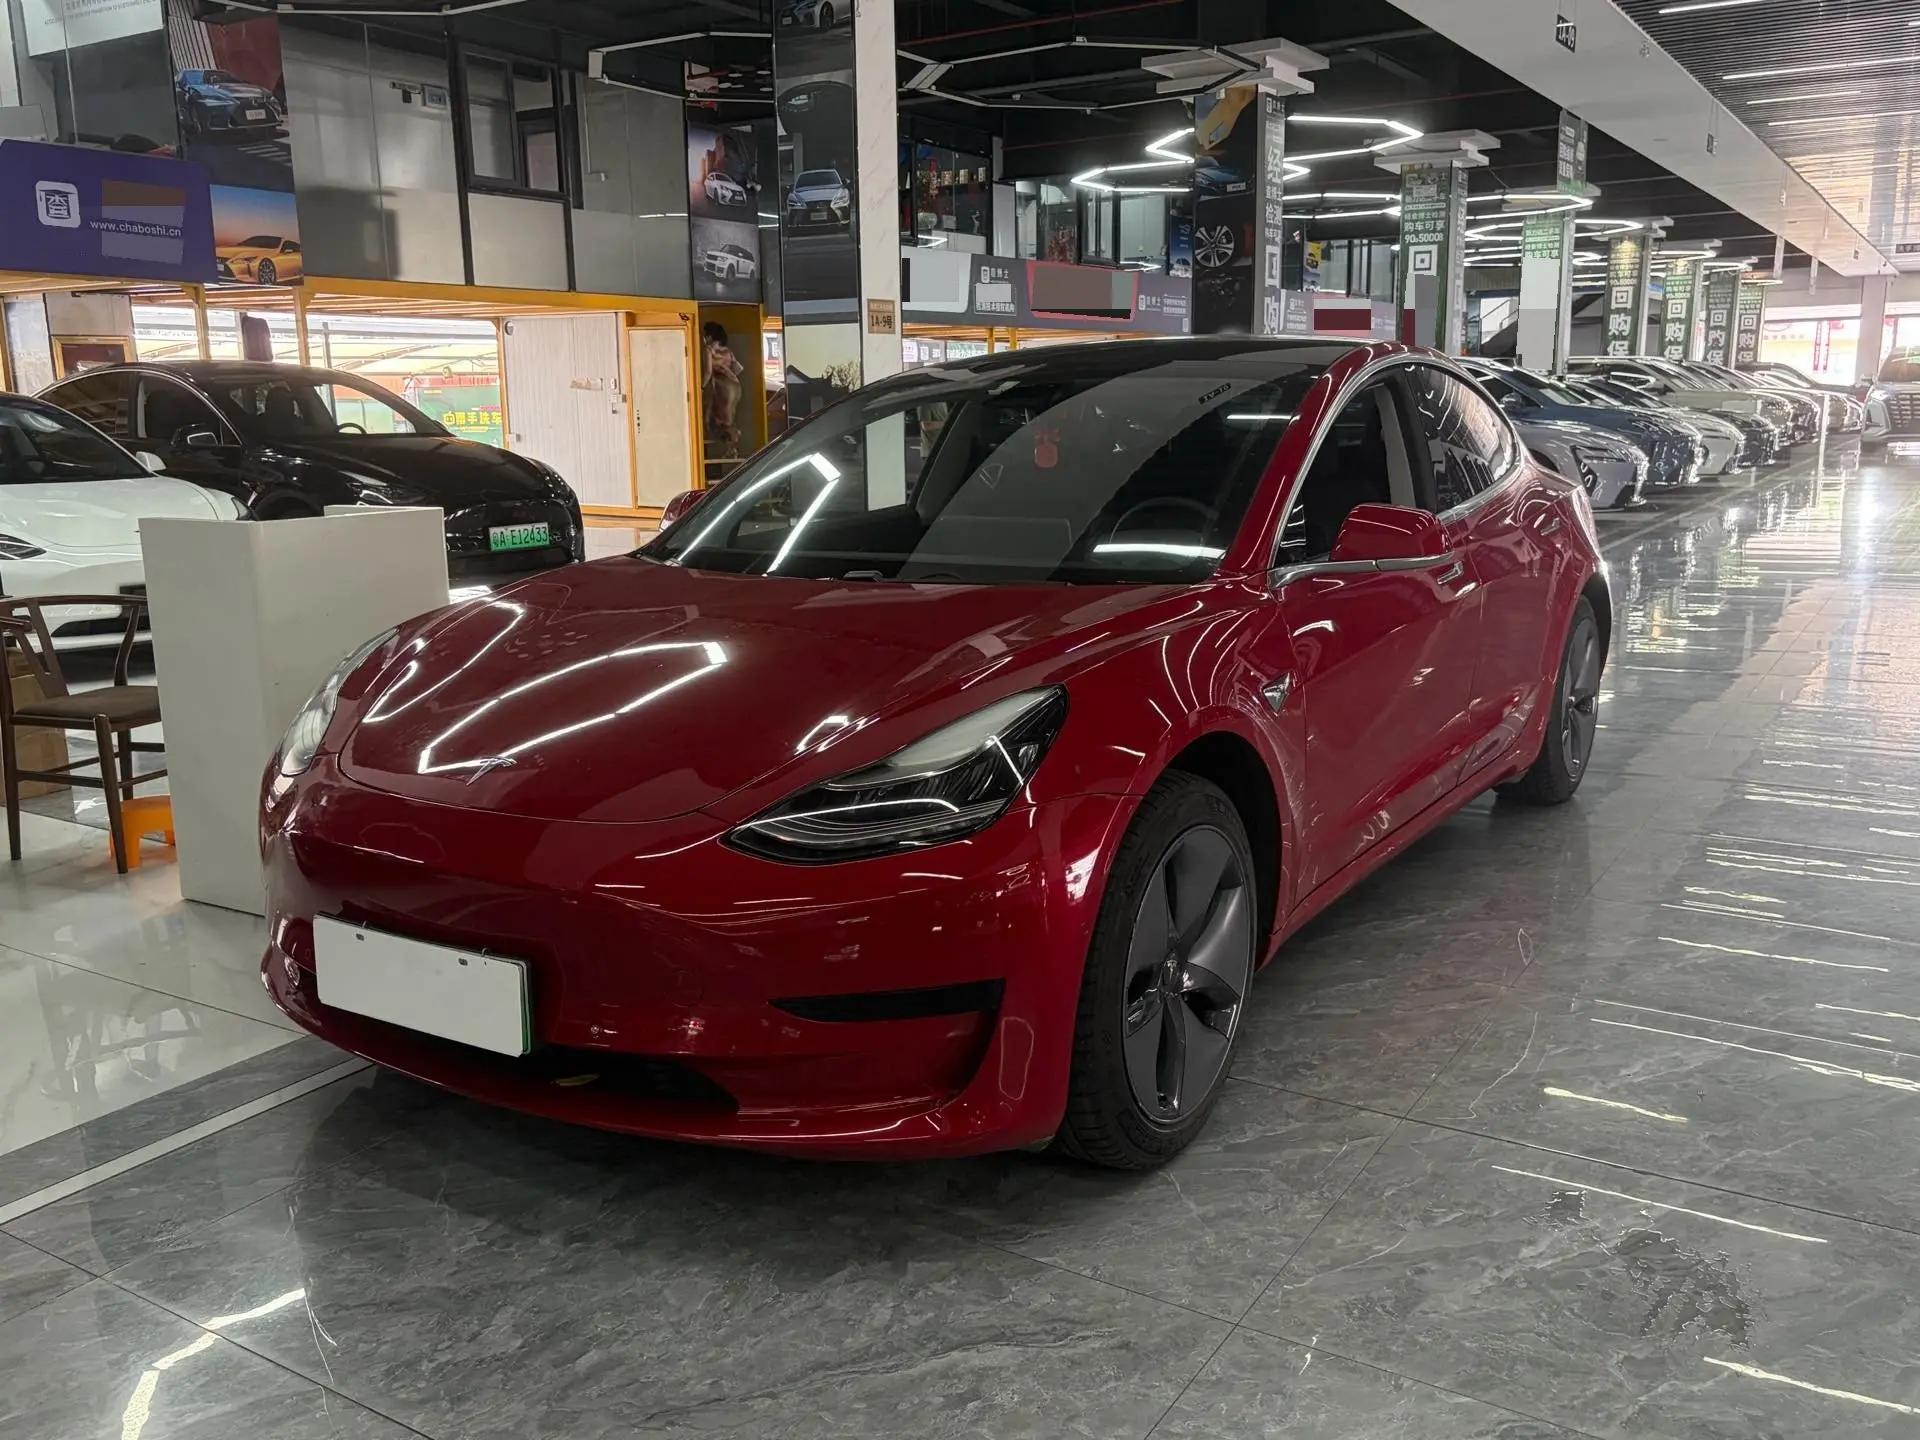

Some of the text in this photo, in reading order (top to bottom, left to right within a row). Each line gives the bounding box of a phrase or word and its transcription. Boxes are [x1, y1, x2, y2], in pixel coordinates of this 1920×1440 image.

[90, 219, 182, 238] www.chaboshi.cn
[1404, 220, 1446, 232] 购车可享
